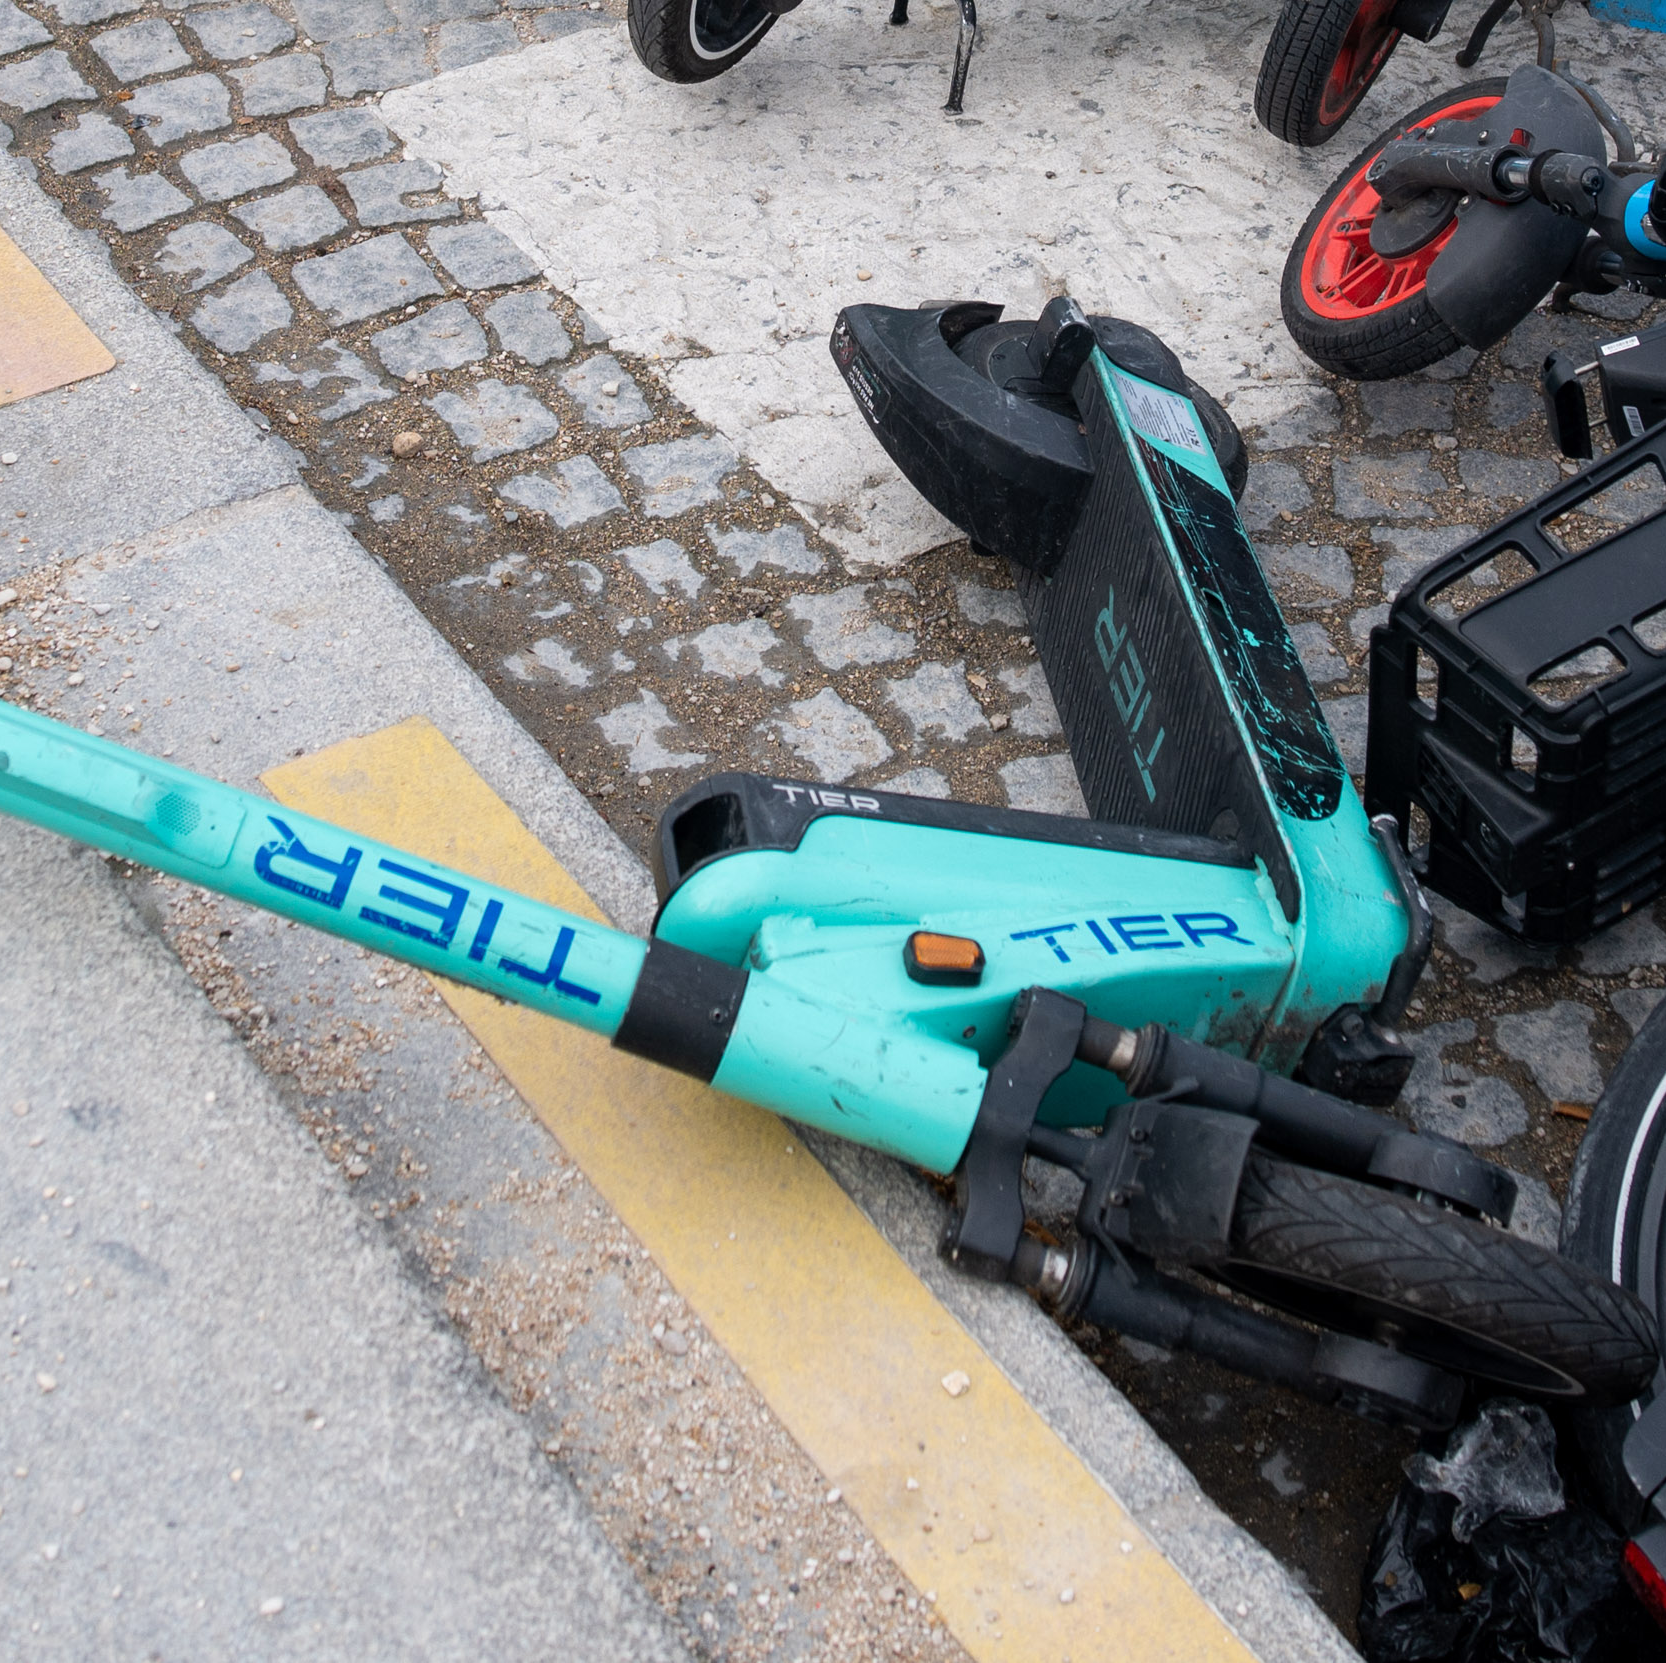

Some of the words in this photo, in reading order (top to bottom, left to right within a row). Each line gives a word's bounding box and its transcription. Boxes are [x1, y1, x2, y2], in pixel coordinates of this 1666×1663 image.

[1094, 584, 1166, 804] TIER
[772, 783, 881, 813] TIER
[254, 815, 602, 1006] TIER
[1010, 912, 1255, 963] TIER
